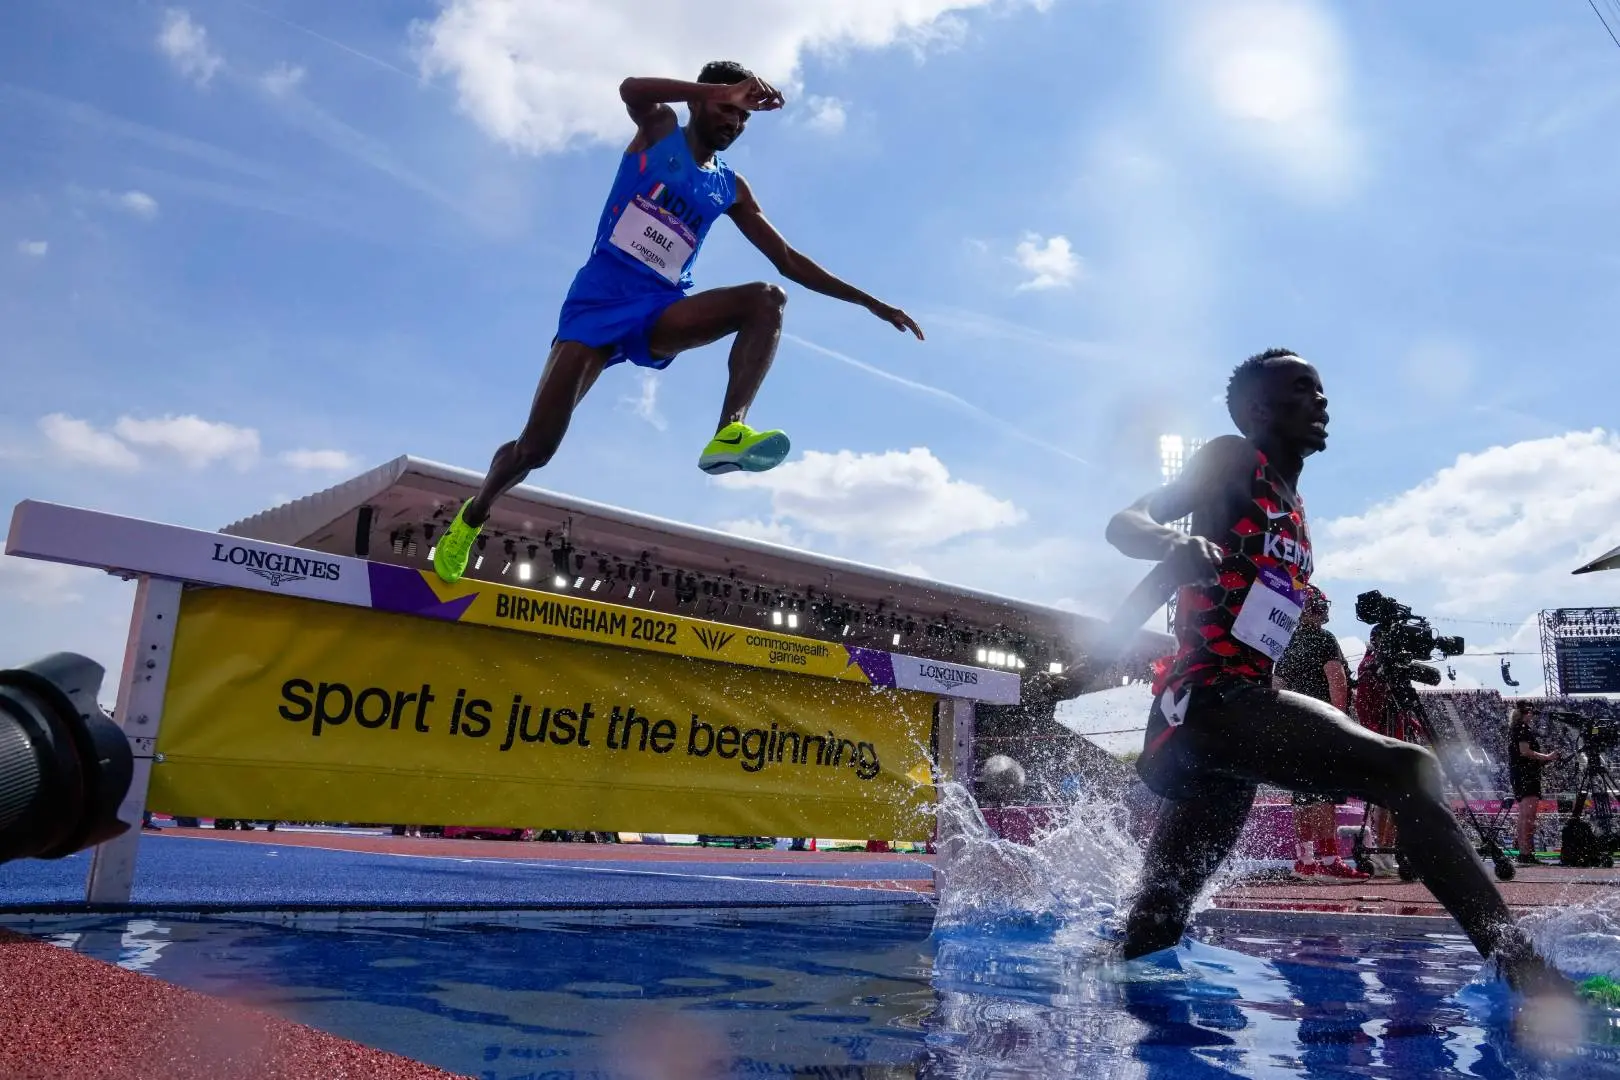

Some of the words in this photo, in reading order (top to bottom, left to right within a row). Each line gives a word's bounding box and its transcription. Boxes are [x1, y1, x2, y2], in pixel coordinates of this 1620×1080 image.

[643, 226, 674, 252] SABLE
[631, 241, 666, 269] LONGINES
[212, 543, 340, 580] LONGINES
[496, 593, 627, 637] BIRMINGHAM
[631, 616, 677, 645] 2022
[746, 634, 828, 658] commonwealth
[769, 649, 807, 666] games
[919, 664, 978, 685] LONGINES
[278, 678, 435, 737] sport
[450, 688, 493, 738] is
[499, 694, 595, 752] just
[605, 705, 677, 754] the
[686, 713, 882, 781] beginning
